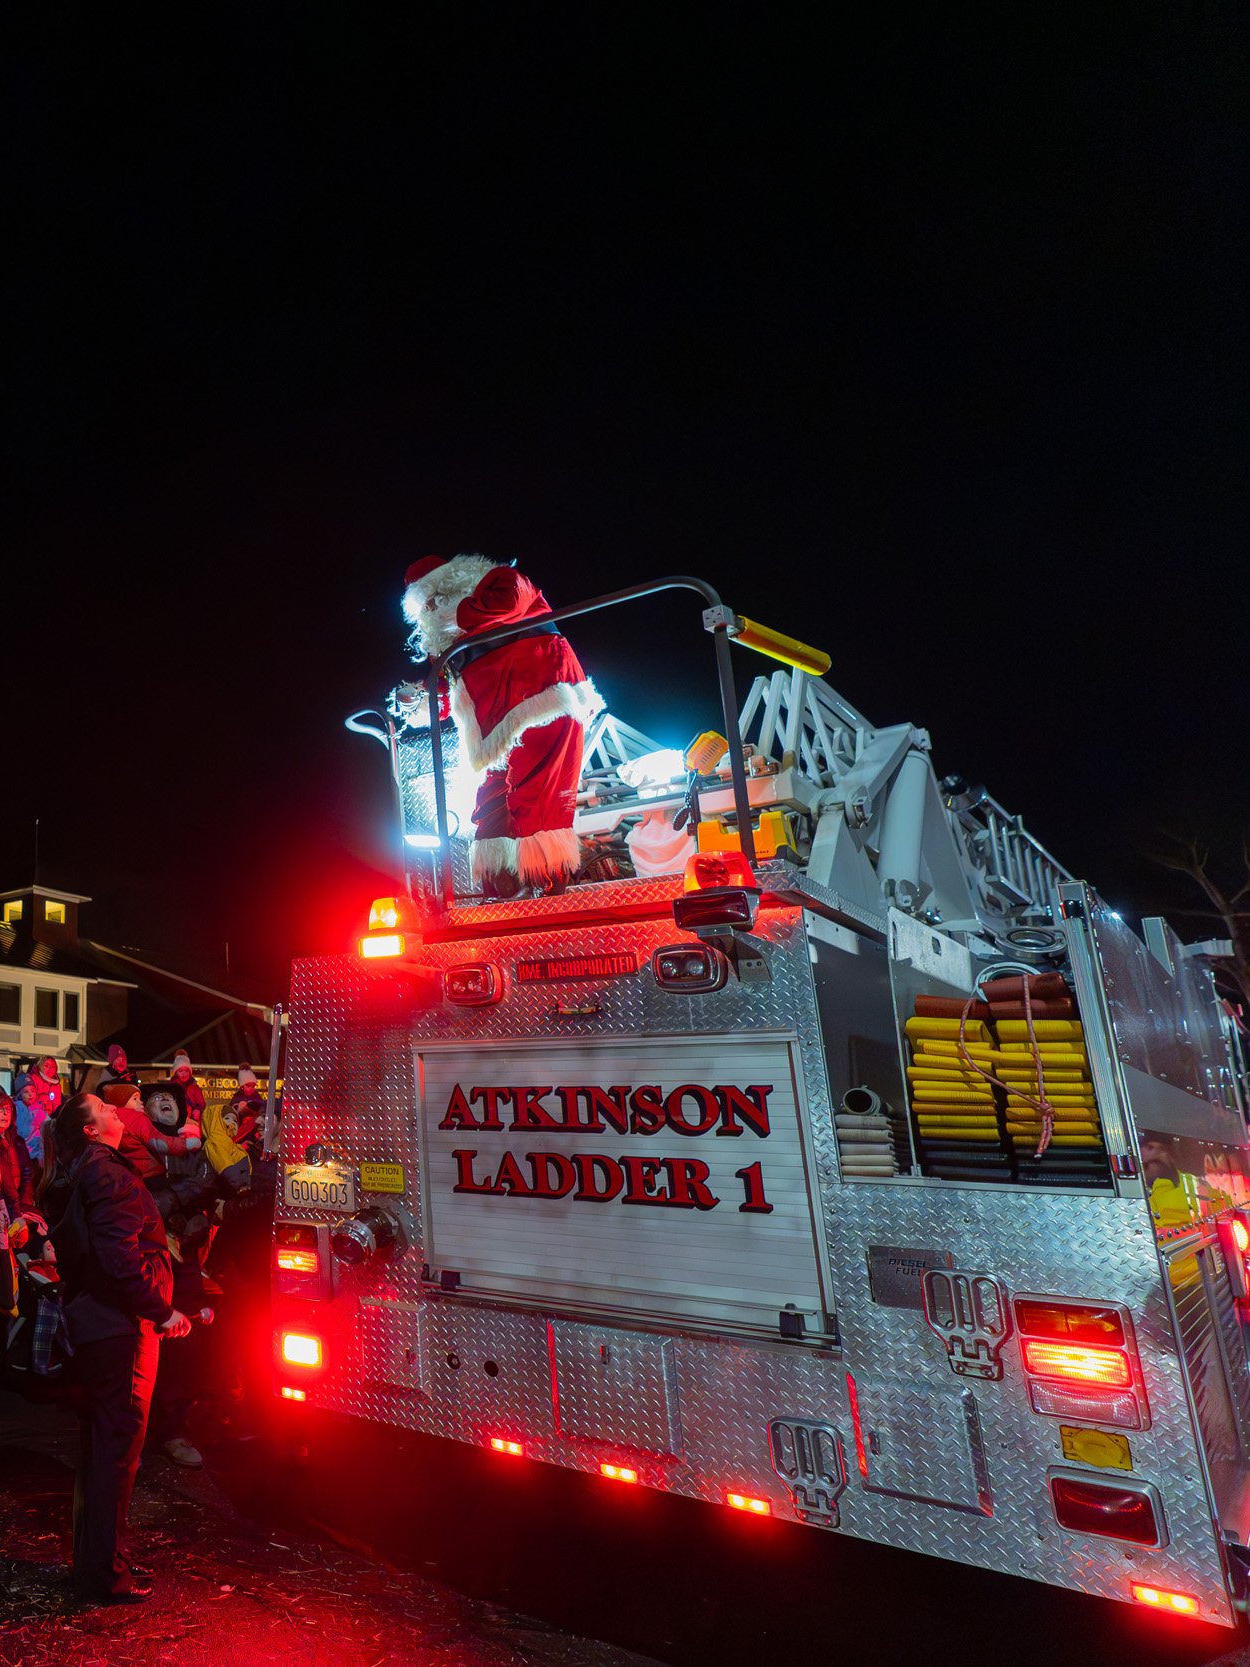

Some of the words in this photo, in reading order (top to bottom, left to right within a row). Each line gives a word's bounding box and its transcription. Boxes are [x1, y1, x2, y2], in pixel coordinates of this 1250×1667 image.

[548, 956, 635, 978] INCORPORATED
[438, 1083, 773, 1139] ATKINSON
[364, 1166, 400, 1176] CAUTION
[452, 1150, 720, 1211] LADDER
[735, 1161, 774, 1214] 1
[291, 1179, 348, 1205] G00303
